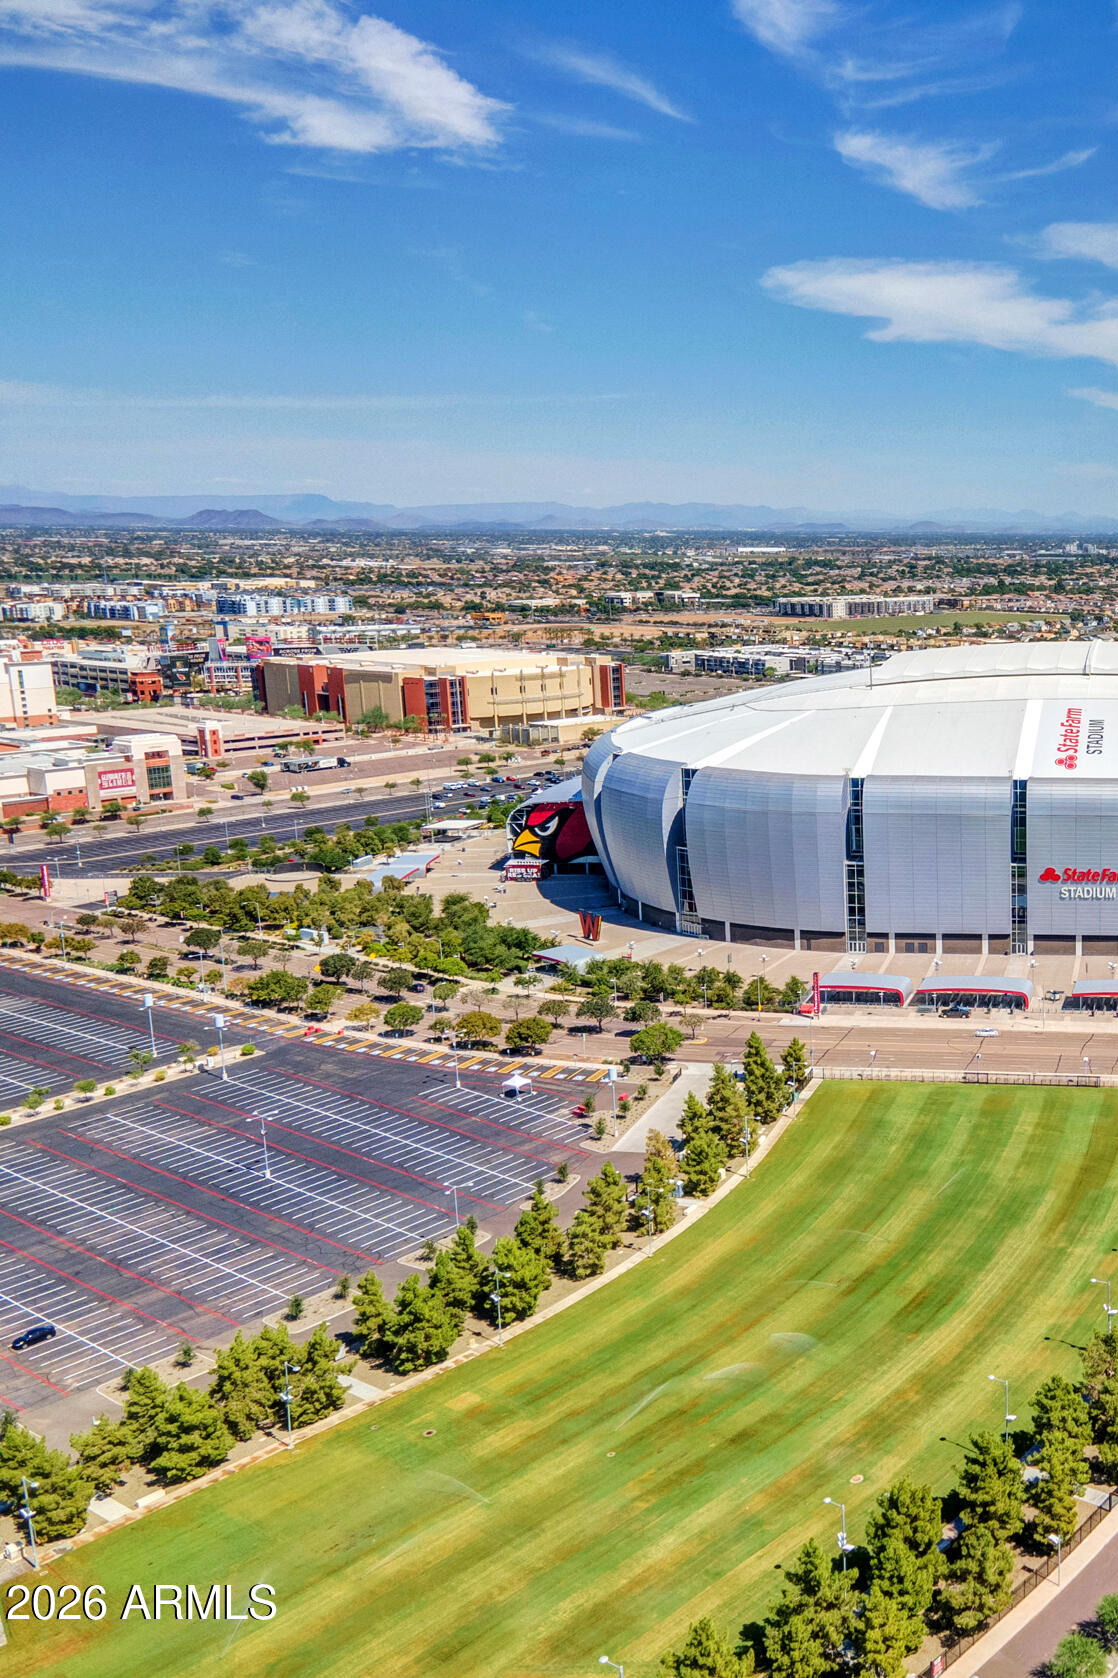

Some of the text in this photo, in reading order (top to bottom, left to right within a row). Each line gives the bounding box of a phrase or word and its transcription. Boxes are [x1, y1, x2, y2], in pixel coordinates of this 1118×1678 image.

[1086, 719, 1105, 755] STADIUM
[1061, 887, 1117, 899] STADIUM
[578, 908, 602, 941] W
